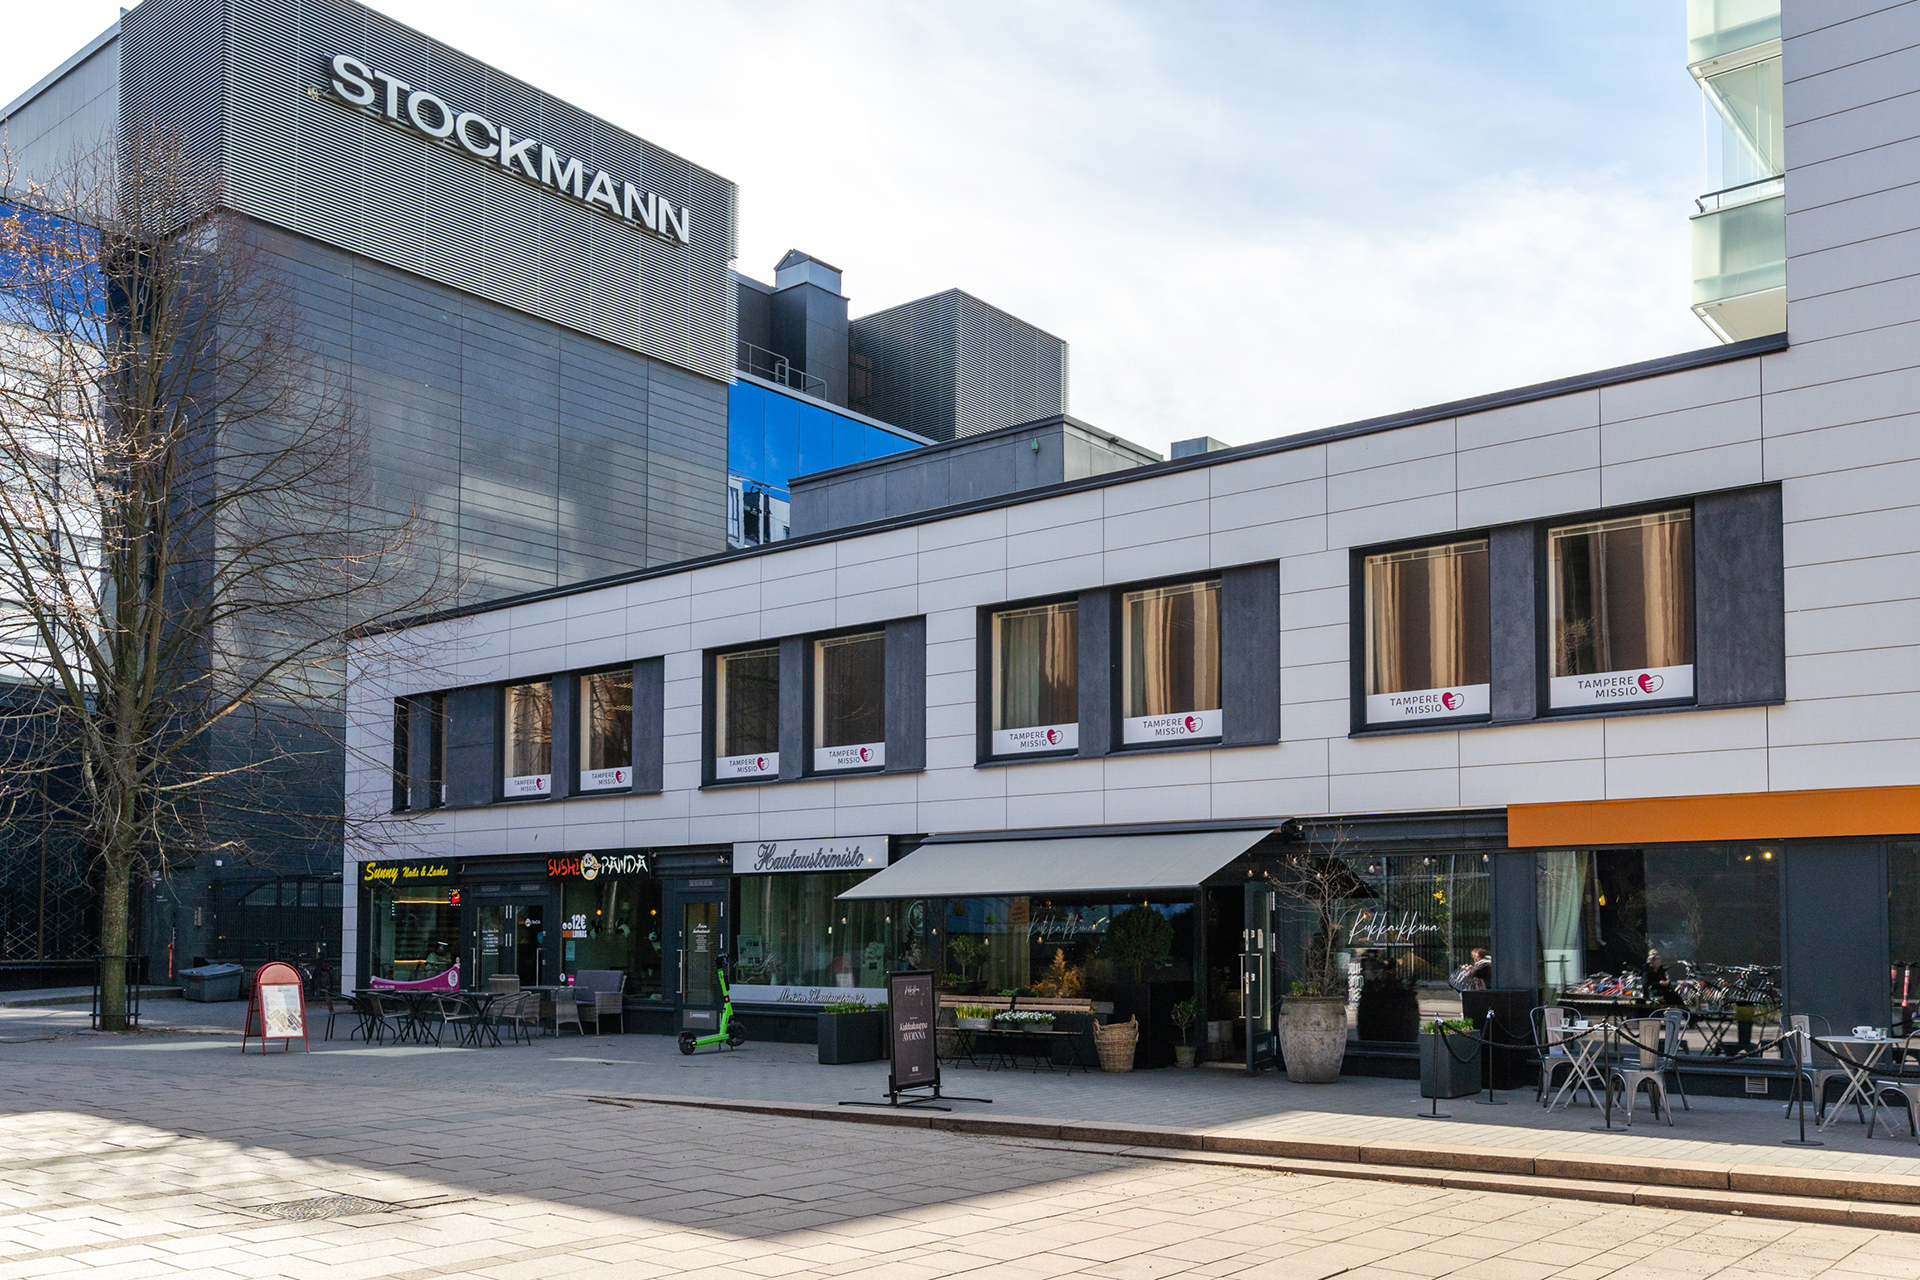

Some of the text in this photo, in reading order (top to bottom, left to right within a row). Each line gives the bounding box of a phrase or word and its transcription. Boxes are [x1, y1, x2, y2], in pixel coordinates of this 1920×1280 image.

[329, 54, 690, 245] STOCKMANN
[1577, 676, 1634, 690] TAMPERE
[1595, 686, 1638, 699] MISSIO
[1390, 694, 1439, 707] TAMPERE
[1404, 703, 1443, 715] MISSIO
[1142, 718, 1182, 728] TAMPERE
[1009, 731, 1045, 741] TAMPERE
[1155, 726, 1186, 736] MISSIO
[1020, 739, 1048, 748] MISSIO
[828, 748, 859, 757] TAMPERE
[729, 758, 756, 767] TAMPERE
[837, 756, 861, 765] MISSIO
[591, 771, 615, 779] TAMPERE
[736, 765, 758, 774] MISSIO
[753, 843, 865, 871] Hautaustoimisto
[547, 854, 649, 877] SUSHI PANDA
[364, 862, 399, 884] Sunny
[420, 865, 427, 877] &
[571, 913, 587, 930] 12€
